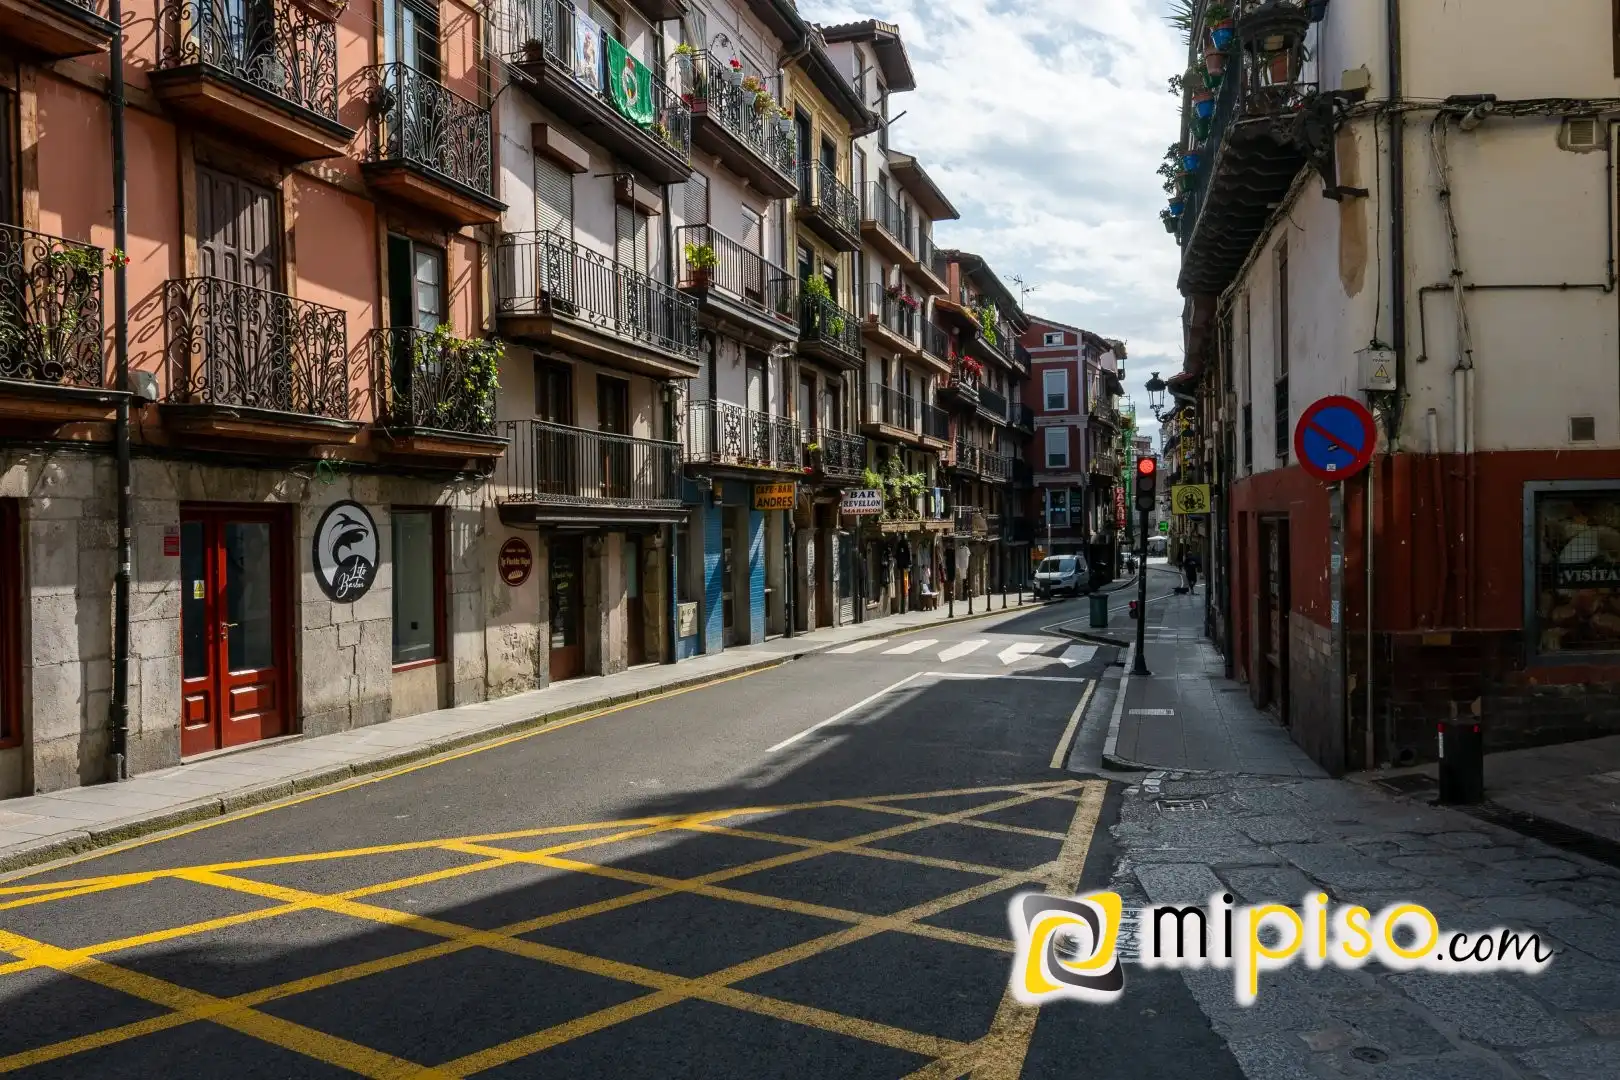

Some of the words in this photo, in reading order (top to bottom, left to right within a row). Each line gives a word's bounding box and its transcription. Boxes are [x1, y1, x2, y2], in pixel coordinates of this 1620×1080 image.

[850, 490, 876, 498] BAR
[756, 496, 793, 507] ANDRES
[843, 499, 881, 508] REVELLON
